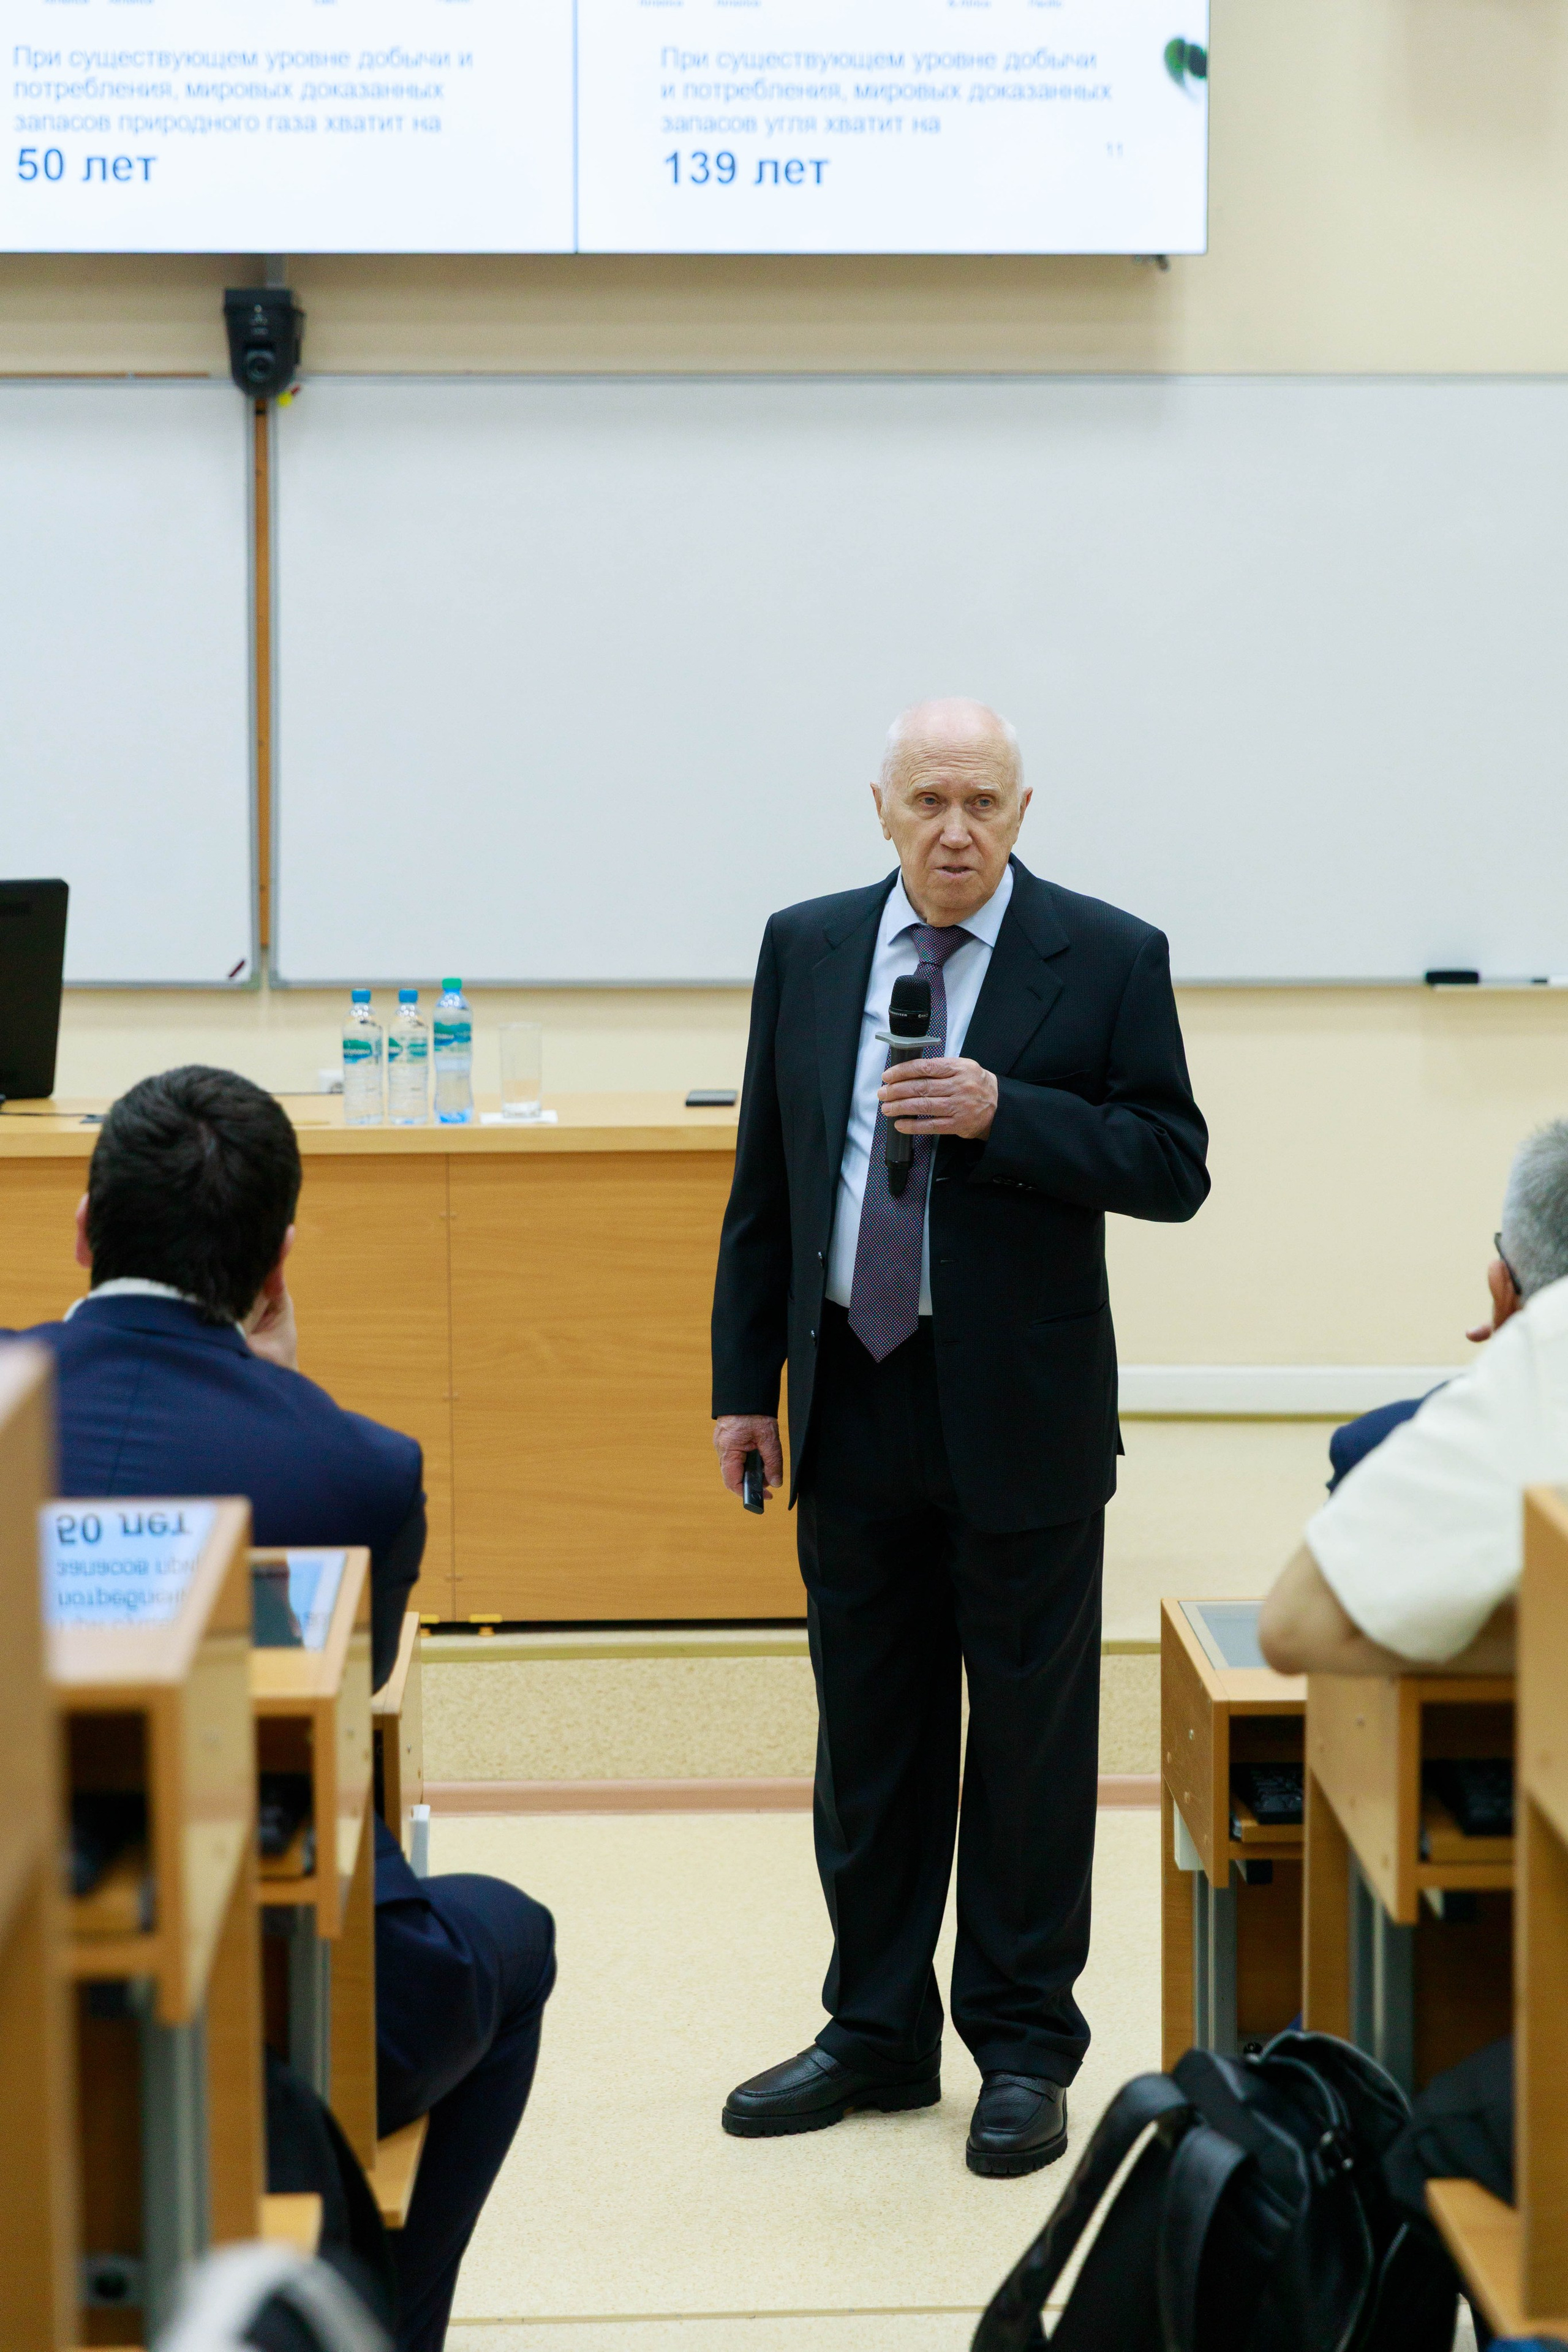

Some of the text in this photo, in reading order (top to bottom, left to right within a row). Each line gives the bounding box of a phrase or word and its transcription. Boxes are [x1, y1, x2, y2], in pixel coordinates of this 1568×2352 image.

[13, 45, 473, 72] При существующем уровне добычи и
[660, 47, 1096, 73] При существующем уровне добычи
[13, 77, 444, 102] потребления, мировых доказанных
[661, 78, 1112, 103] и потребления, мировых доказанных
[14, 115, 442, 135] запасов природного газа хватит на
[662, 115, 941, 137] запасов угля хватит на
[17, 146, 157, 183] 50 лет
[665, 150, 829, 186] 139 лет
